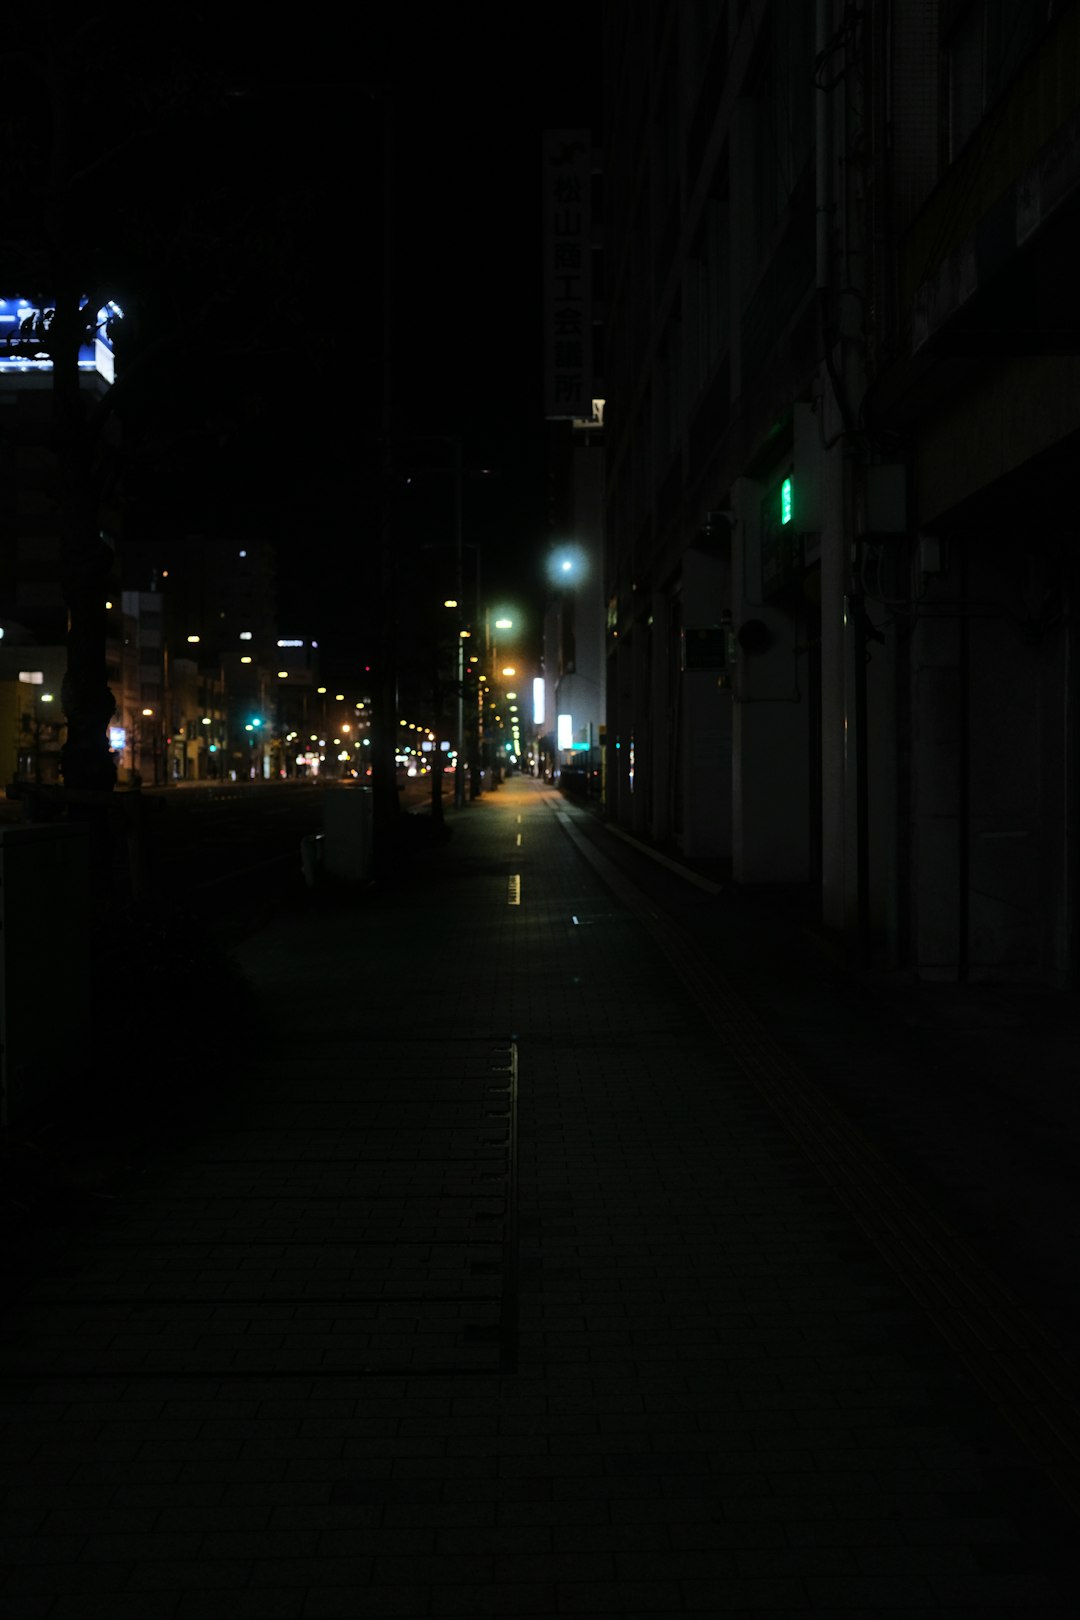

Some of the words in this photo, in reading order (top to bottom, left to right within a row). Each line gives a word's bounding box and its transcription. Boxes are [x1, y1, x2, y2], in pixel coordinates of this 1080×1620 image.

[554, 174, 583, 403] 松山商工会議所
